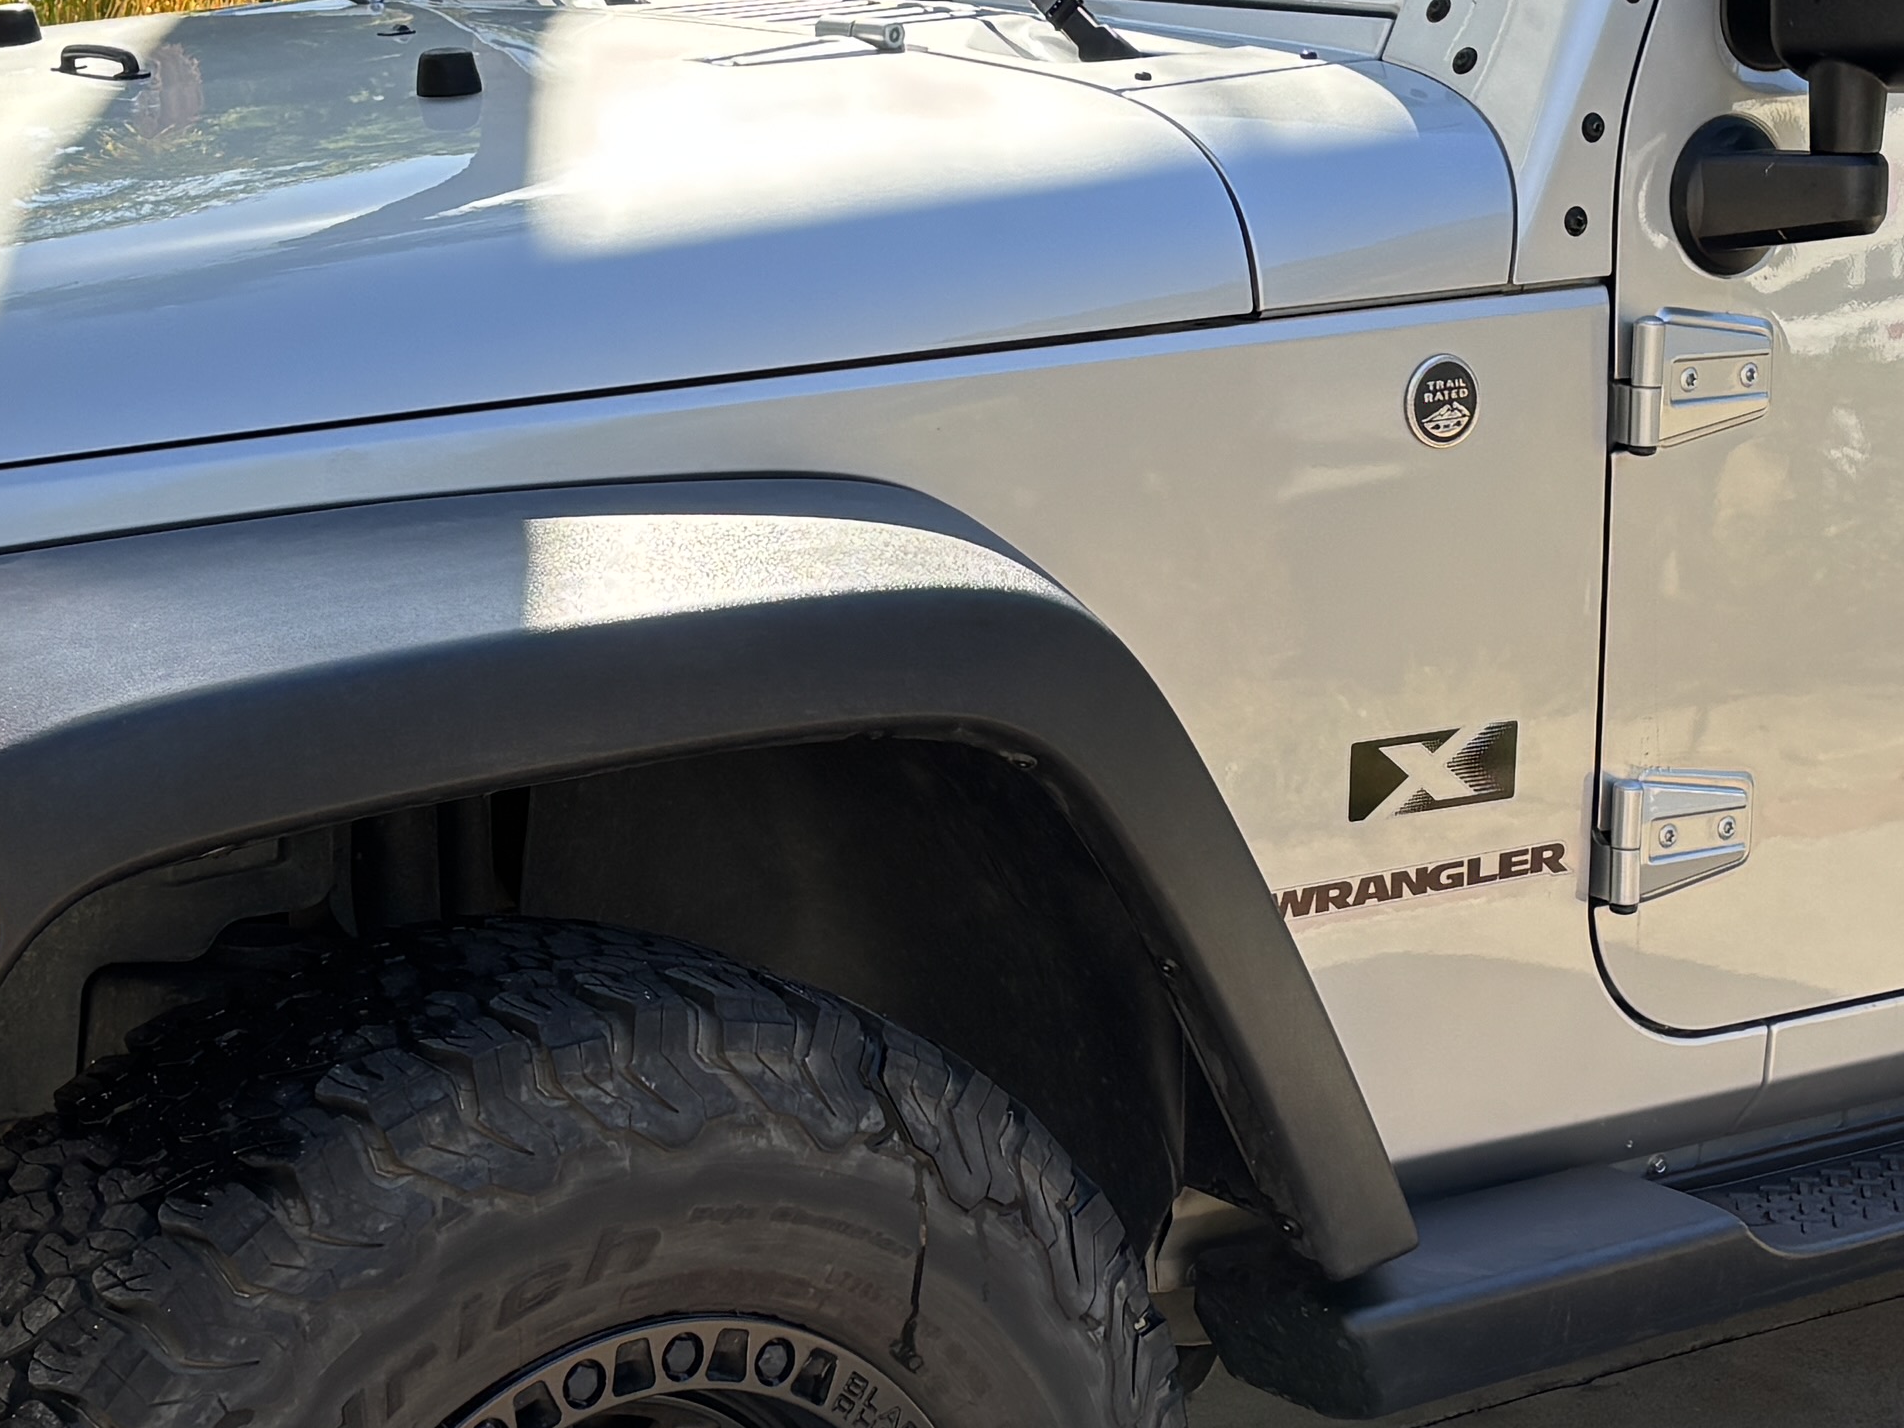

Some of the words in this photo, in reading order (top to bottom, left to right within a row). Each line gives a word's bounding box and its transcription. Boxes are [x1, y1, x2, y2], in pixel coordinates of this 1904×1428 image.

[1426, 378, 1466, 392] TRAIL
[1424, 388, 1469, 403] RATED
[1274, 843, 1568, 917] WRANGLER
